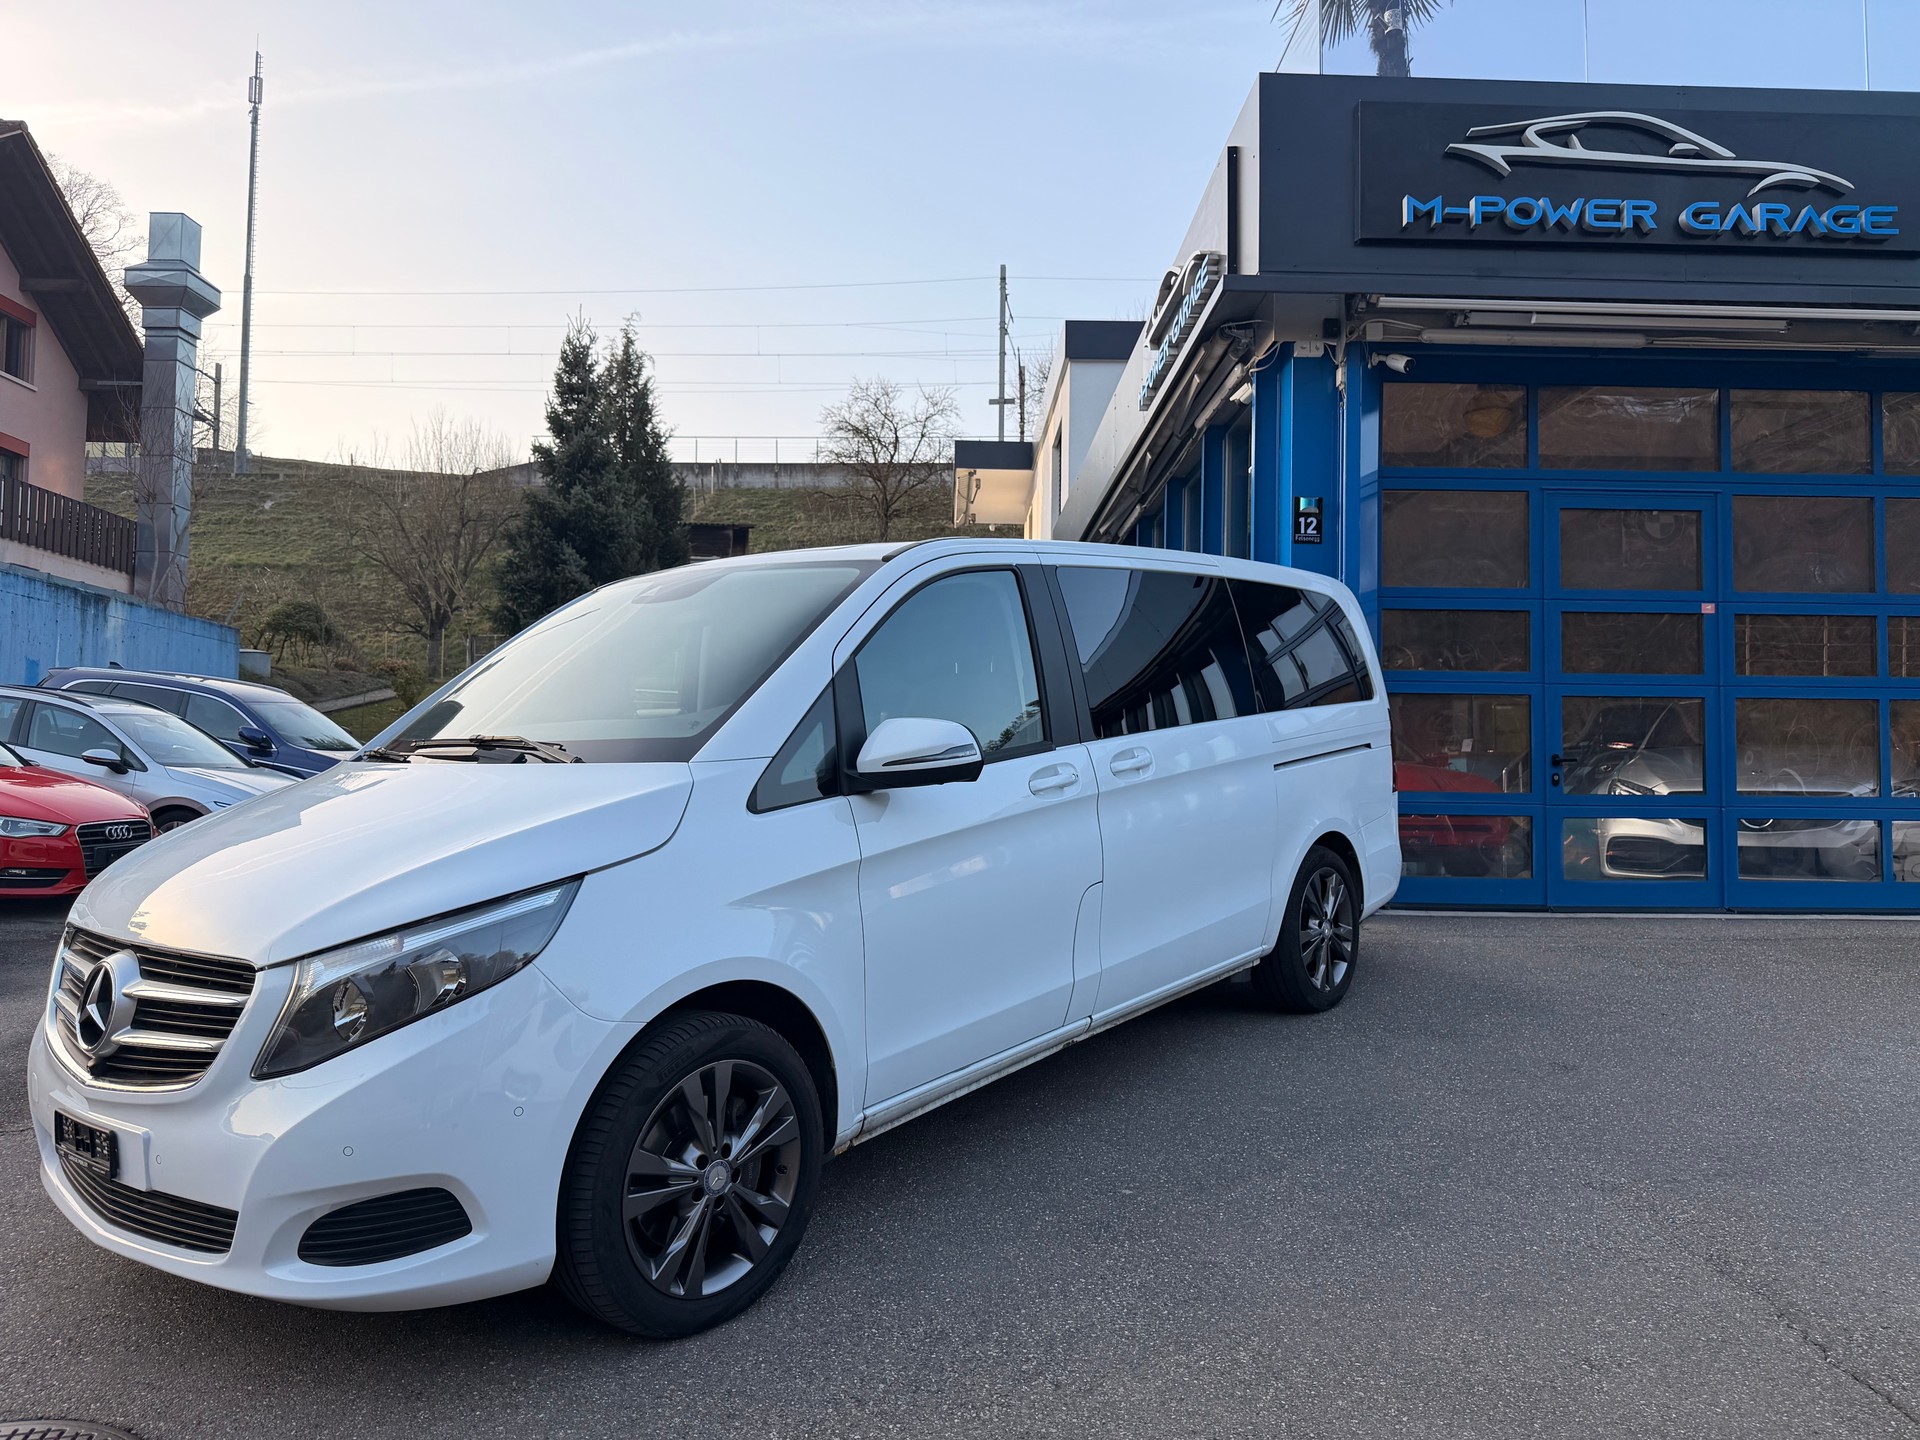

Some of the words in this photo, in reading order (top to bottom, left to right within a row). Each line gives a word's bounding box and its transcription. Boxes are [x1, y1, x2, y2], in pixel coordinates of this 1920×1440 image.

[1402, 194, 1658, 232] M-POWER
[1680, 200, 1900, 238] GARAGE
[1171, 254, 1210, 344] GARAGE
[1299, 516, 1317, 534] 12
